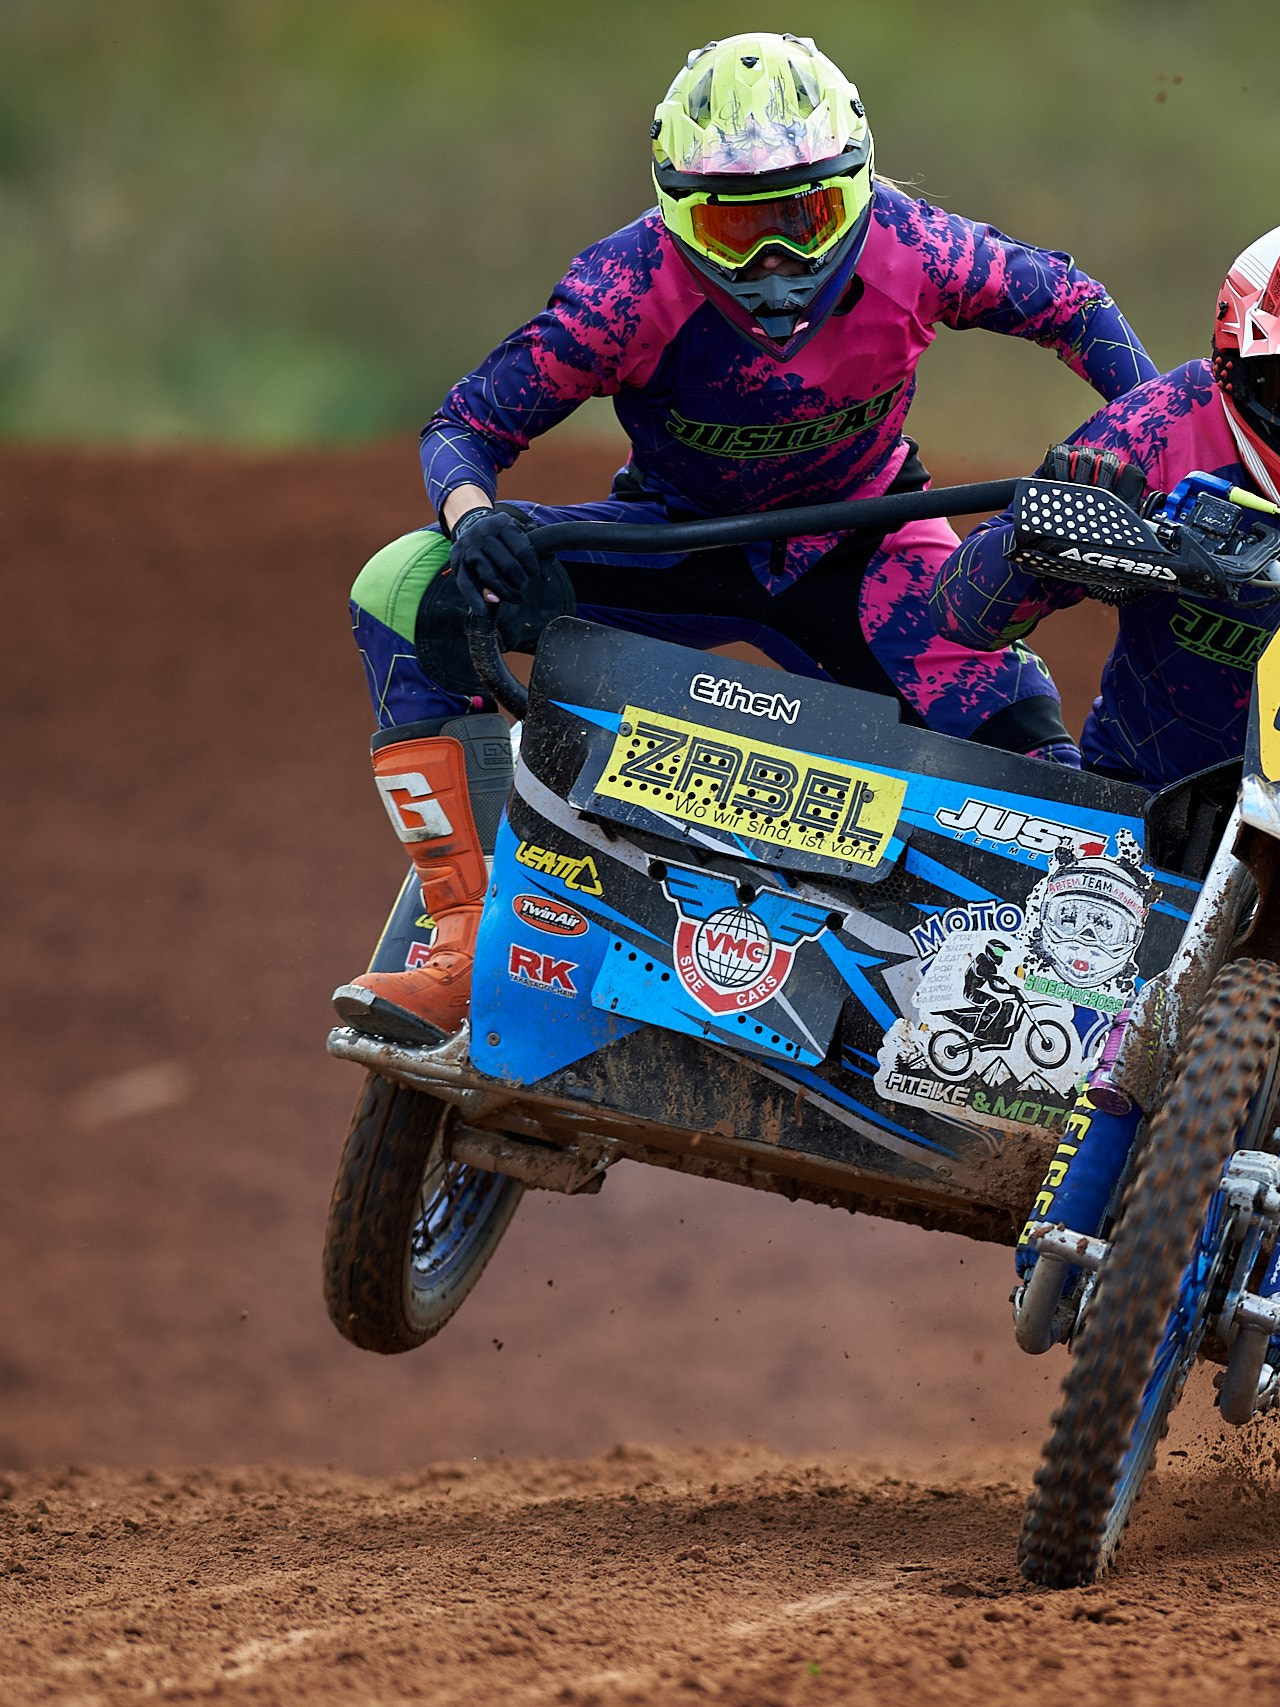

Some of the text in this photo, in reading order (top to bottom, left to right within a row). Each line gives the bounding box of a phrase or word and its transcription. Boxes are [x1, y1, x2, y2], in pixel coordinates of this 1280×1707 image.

[1059, 547, 1177, 581] ACERBIS
[619, 721, 883, 846] ZABEL
[674, 796, 875, 863] Wo wir sind, ist vorn.
[1080, 874, 1113, 892] TEAM
[705, 928, 765, 964] VMC
[909, 901, 1025, 958] MOTO
[509, 942, 579, 993] RK
[680, 955, 777, 1006] SIDE CARS
